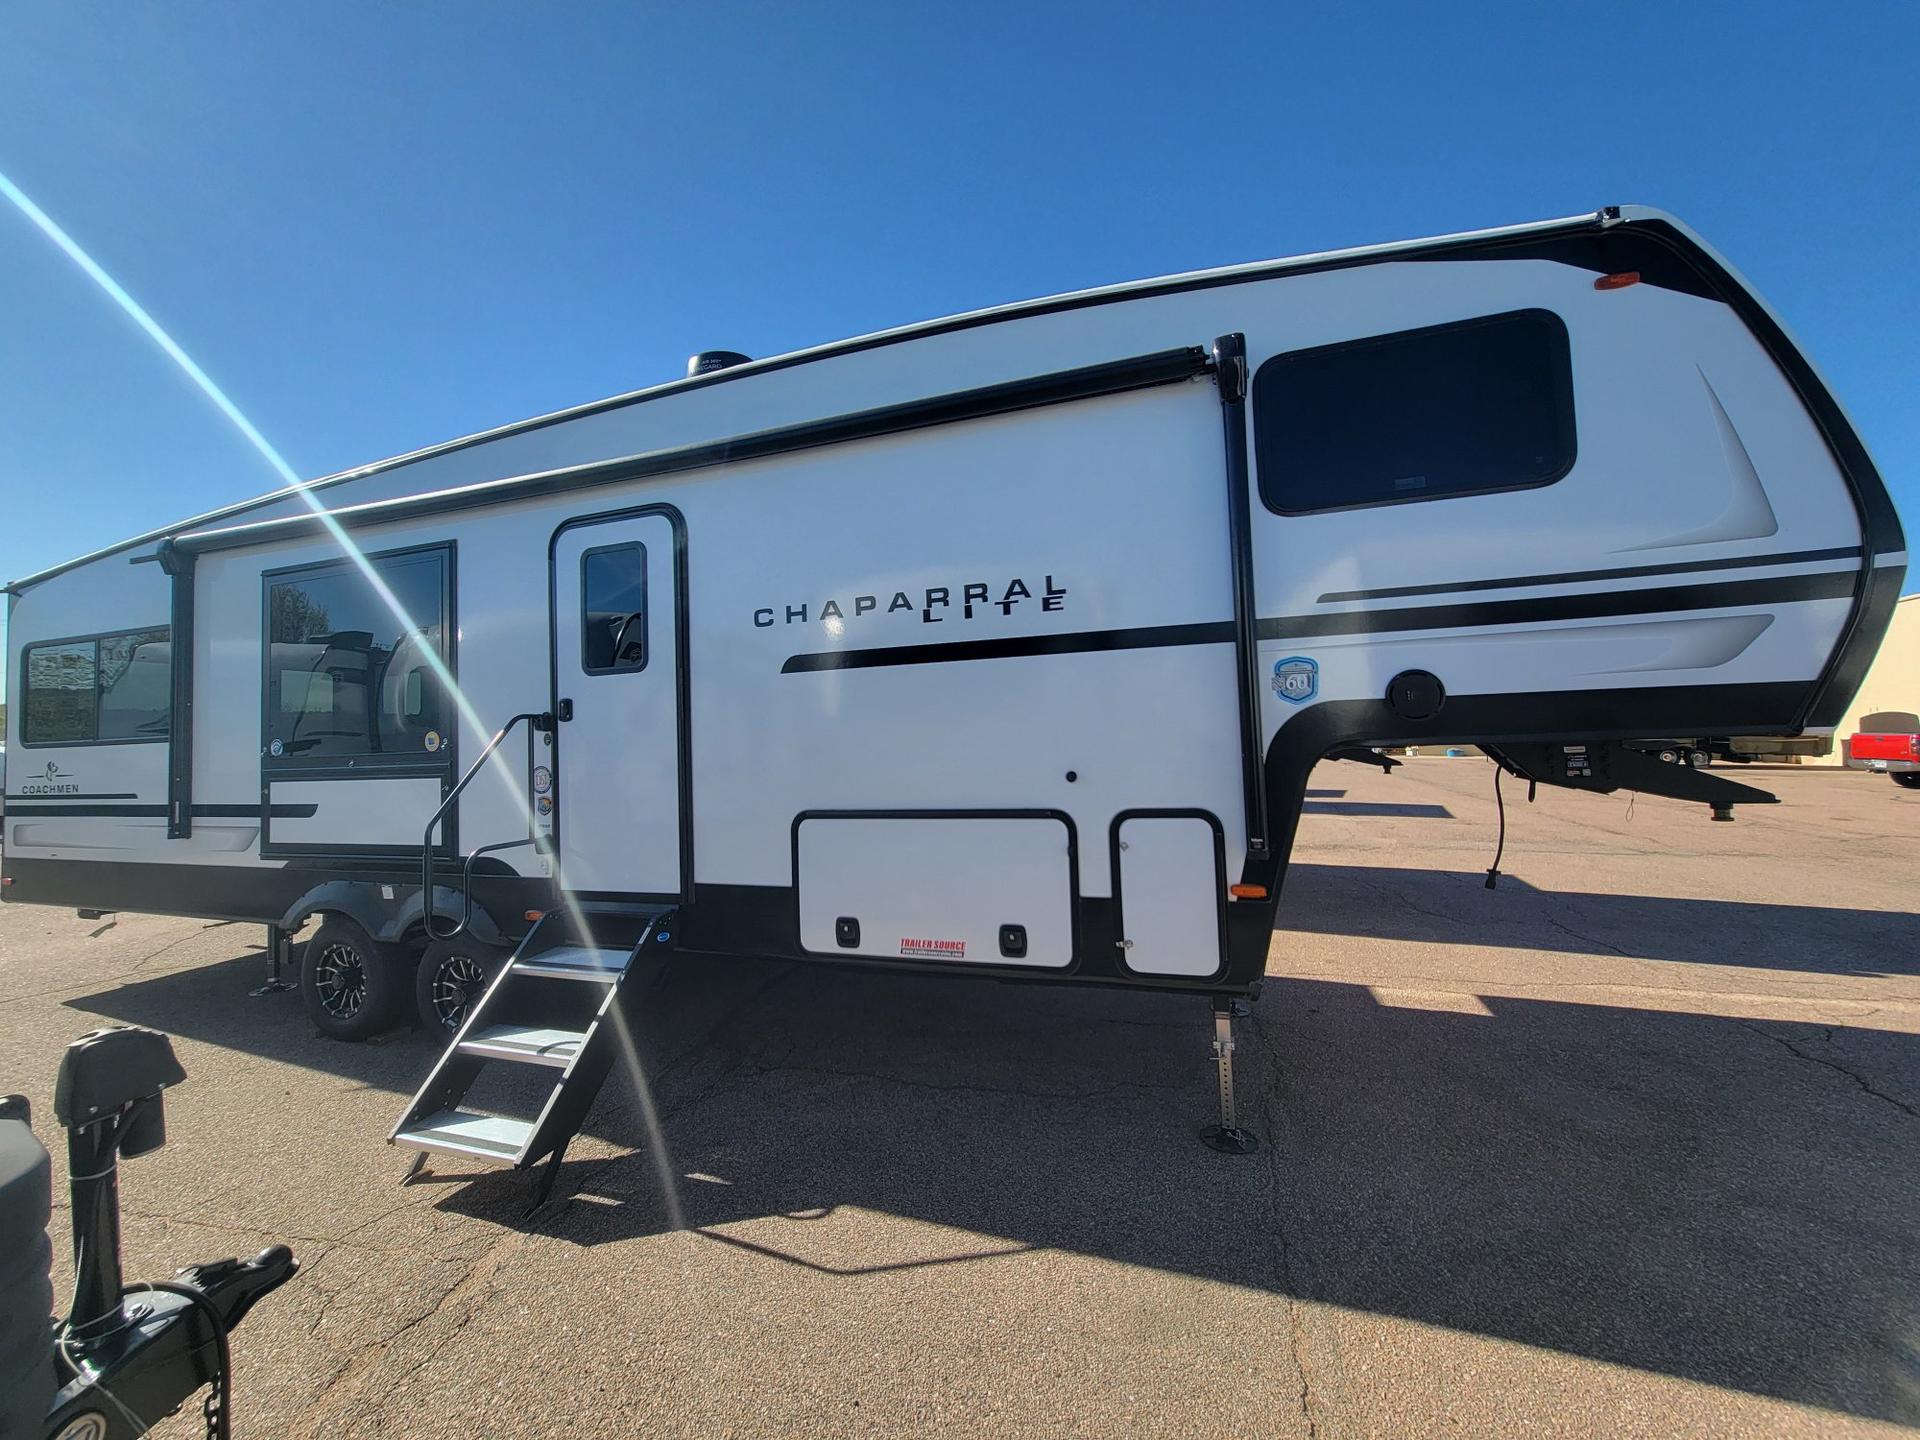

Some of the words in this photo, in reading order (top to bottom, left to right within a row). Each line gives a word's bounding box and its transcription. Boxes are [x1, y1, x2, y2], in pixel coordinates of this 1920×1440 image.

[753, 575, 1067, 628] CHAPARRAL
[922, 595, 1065, 623] LITE
[22, 784, 79, 794] COACHMEN
[900, 938, 933, 949] TRAILER
[933, 940, 967, 951] SOURCE
